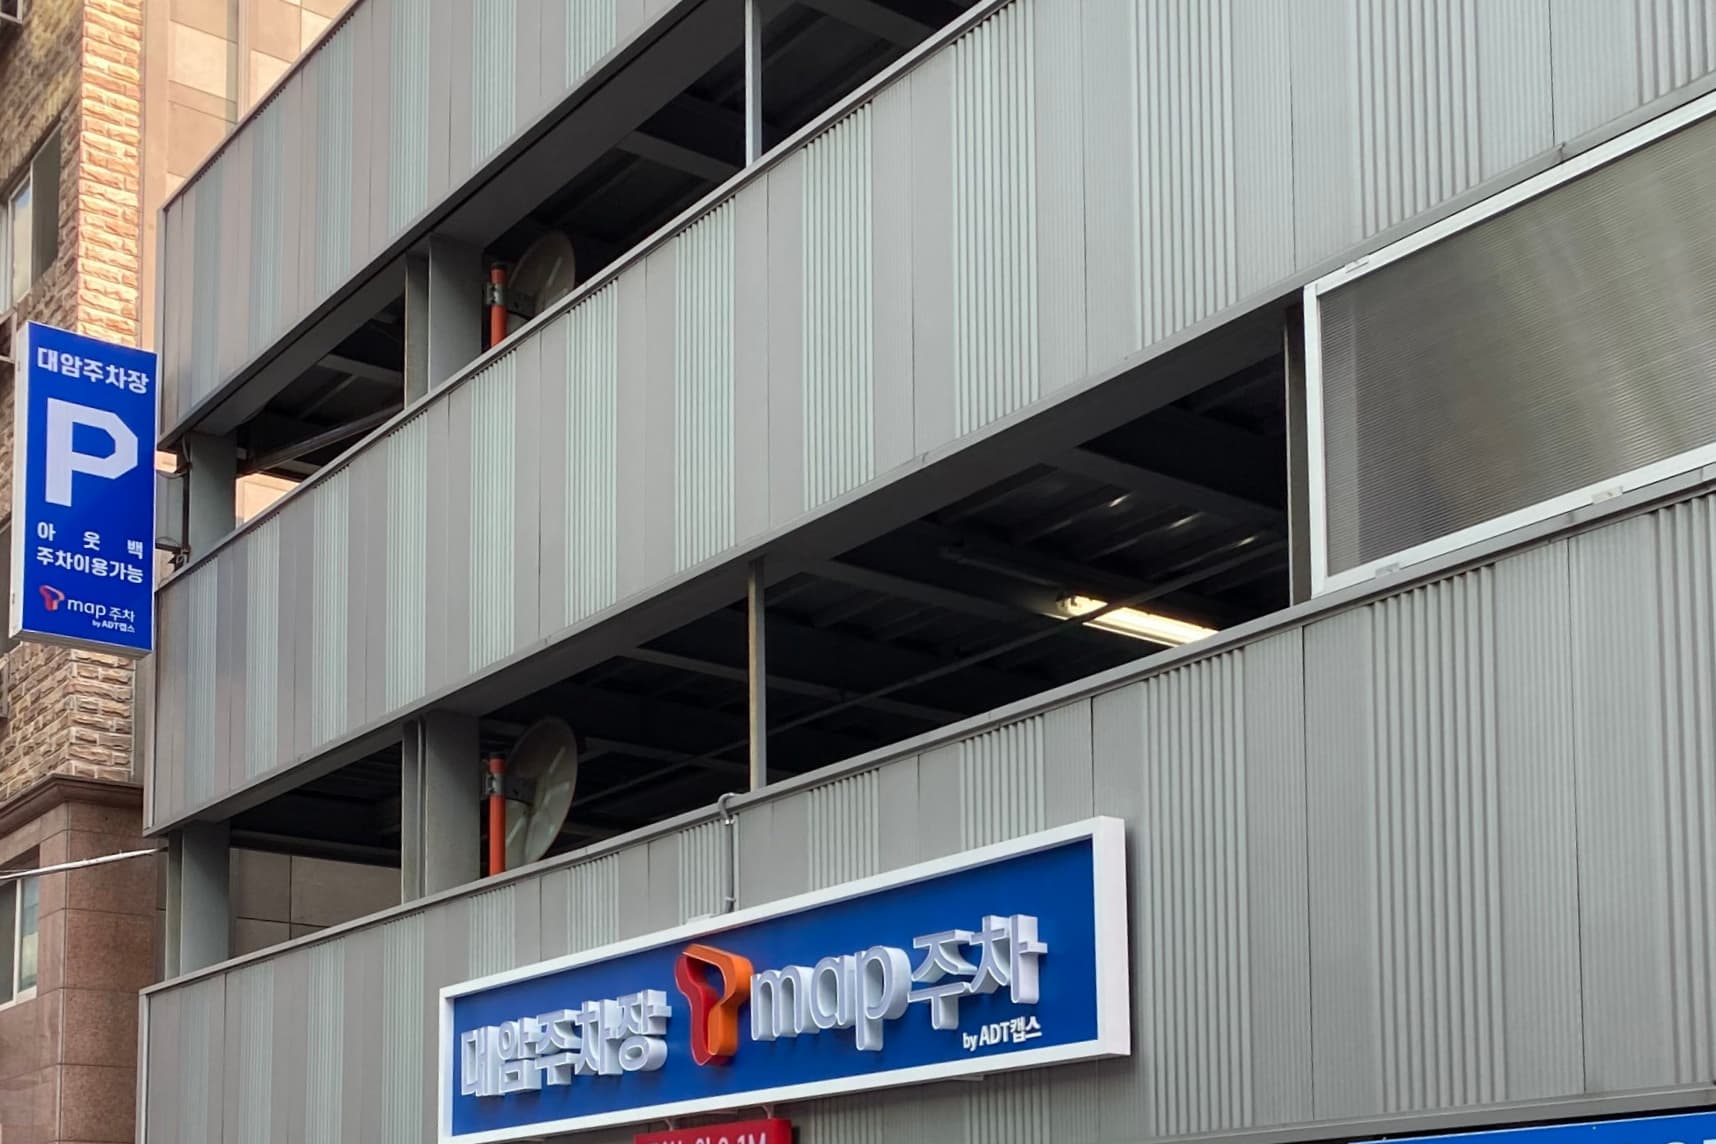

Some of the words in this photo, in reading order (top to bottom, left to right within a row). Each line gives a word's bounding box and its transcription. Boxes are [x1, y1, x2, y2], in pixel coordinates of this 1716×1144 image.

[37, 347, 149, 394] 대암주차장
[45, 397, 138, 507] P
[36, 546, 144, 584] 주차이용가능
[67, 598, 106, 618] map
[109, 606, 136, 623] 주차
[461, 989, 672, 1097] 대암주차장
[750, 945, 912, 1051] map
[907, 914, 1048, 1030] 주차
[962, 1032, 979, 1051] by
[980, 1015, 1042, 1047] ADT캡스
